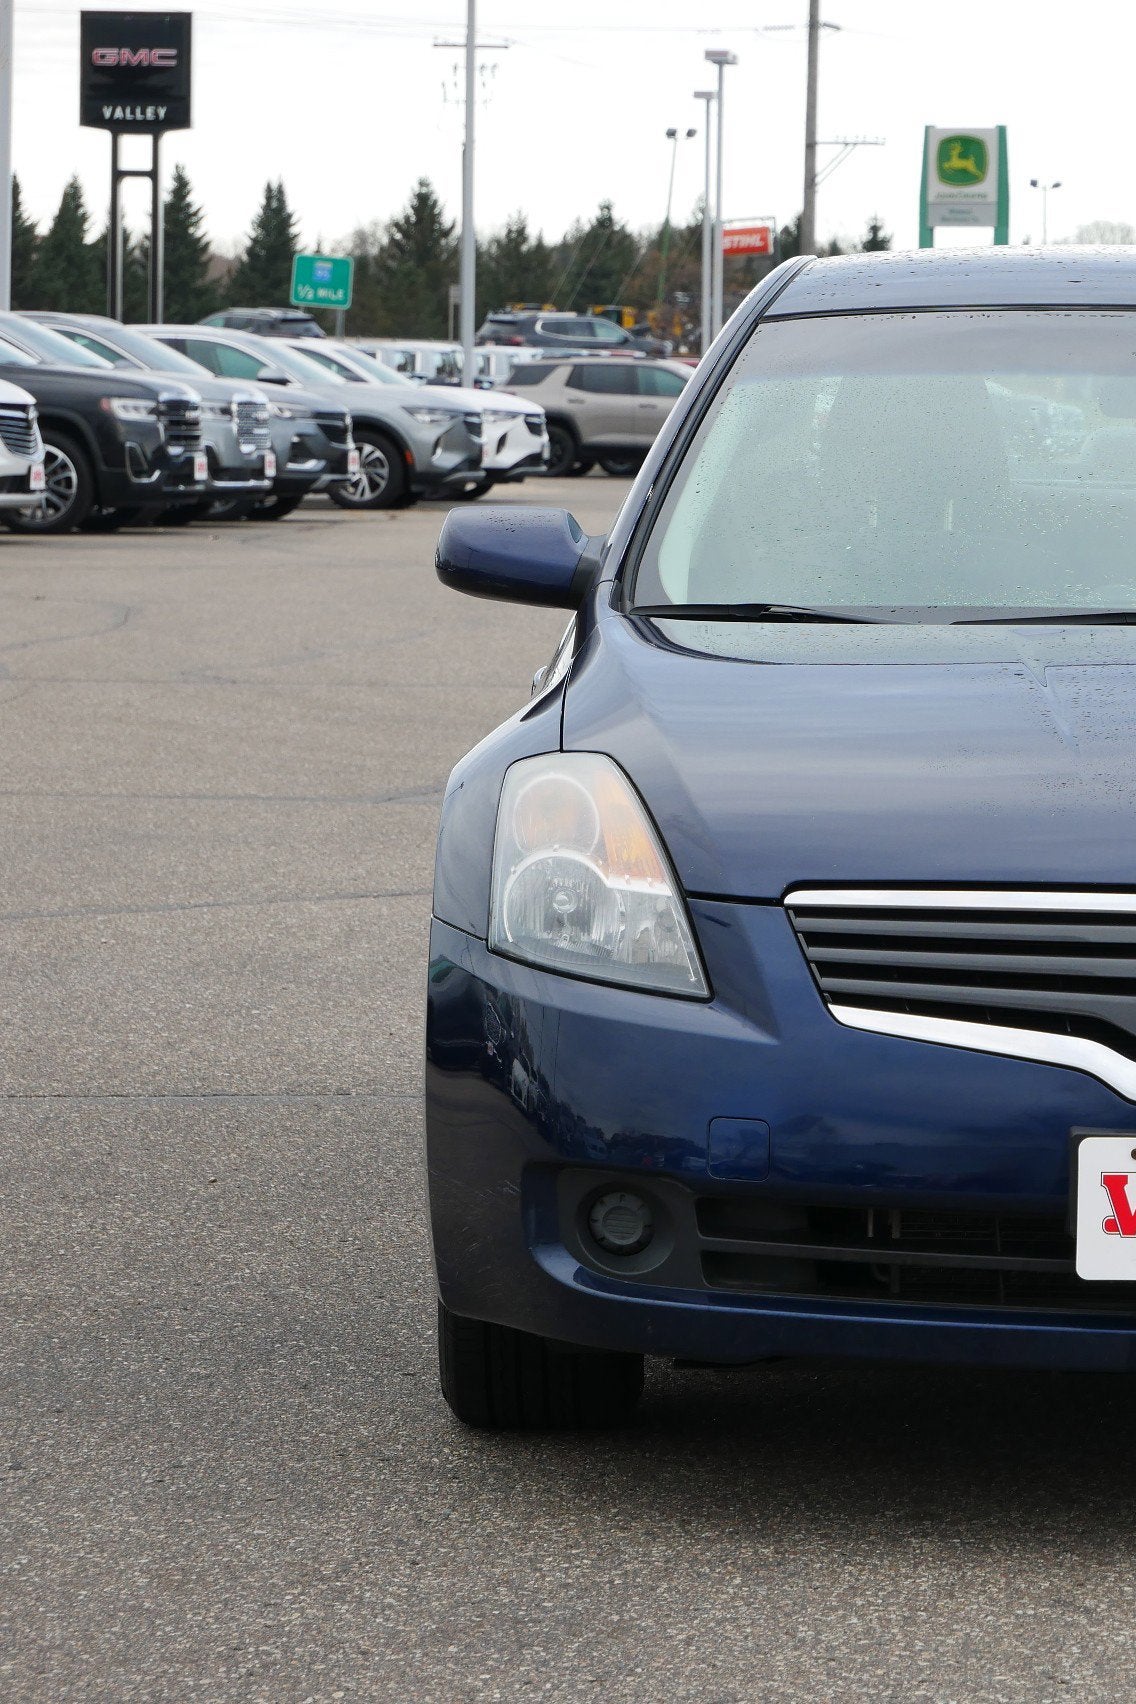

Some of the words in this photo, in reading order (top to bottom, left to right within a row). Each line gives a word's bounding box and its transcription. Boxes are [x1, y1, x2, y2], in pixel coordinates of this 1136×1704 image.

[92, 47, 178, 67] GMC
[102, 104, 168, 121] VALLEY
[316, 286, 345, 301] MILE
